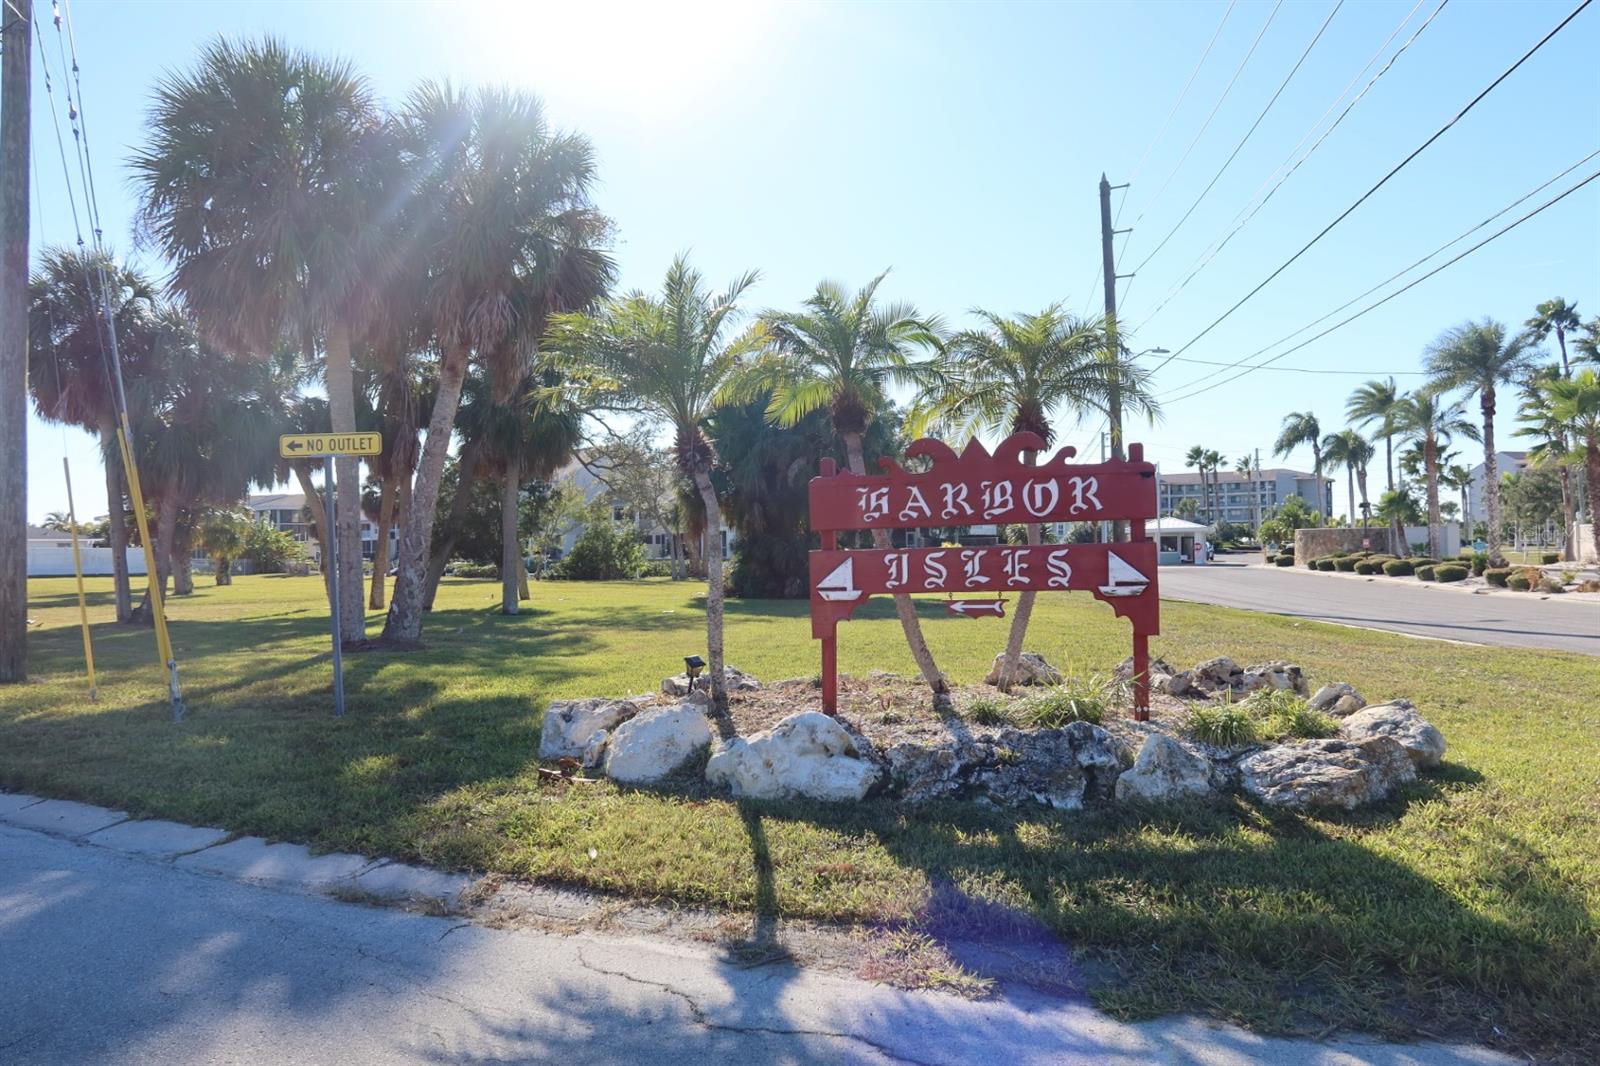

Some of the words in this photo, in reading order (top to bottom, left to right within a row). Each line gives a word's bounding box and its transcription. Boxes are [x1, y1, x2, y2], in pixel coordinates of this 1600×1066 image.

[307, 439, 323, 451] NO
[329, 438, 373, 451] OUTLET
[856, 476, 1103, 521] HARBOR
[884, 549, 1072, 589] ISLES
